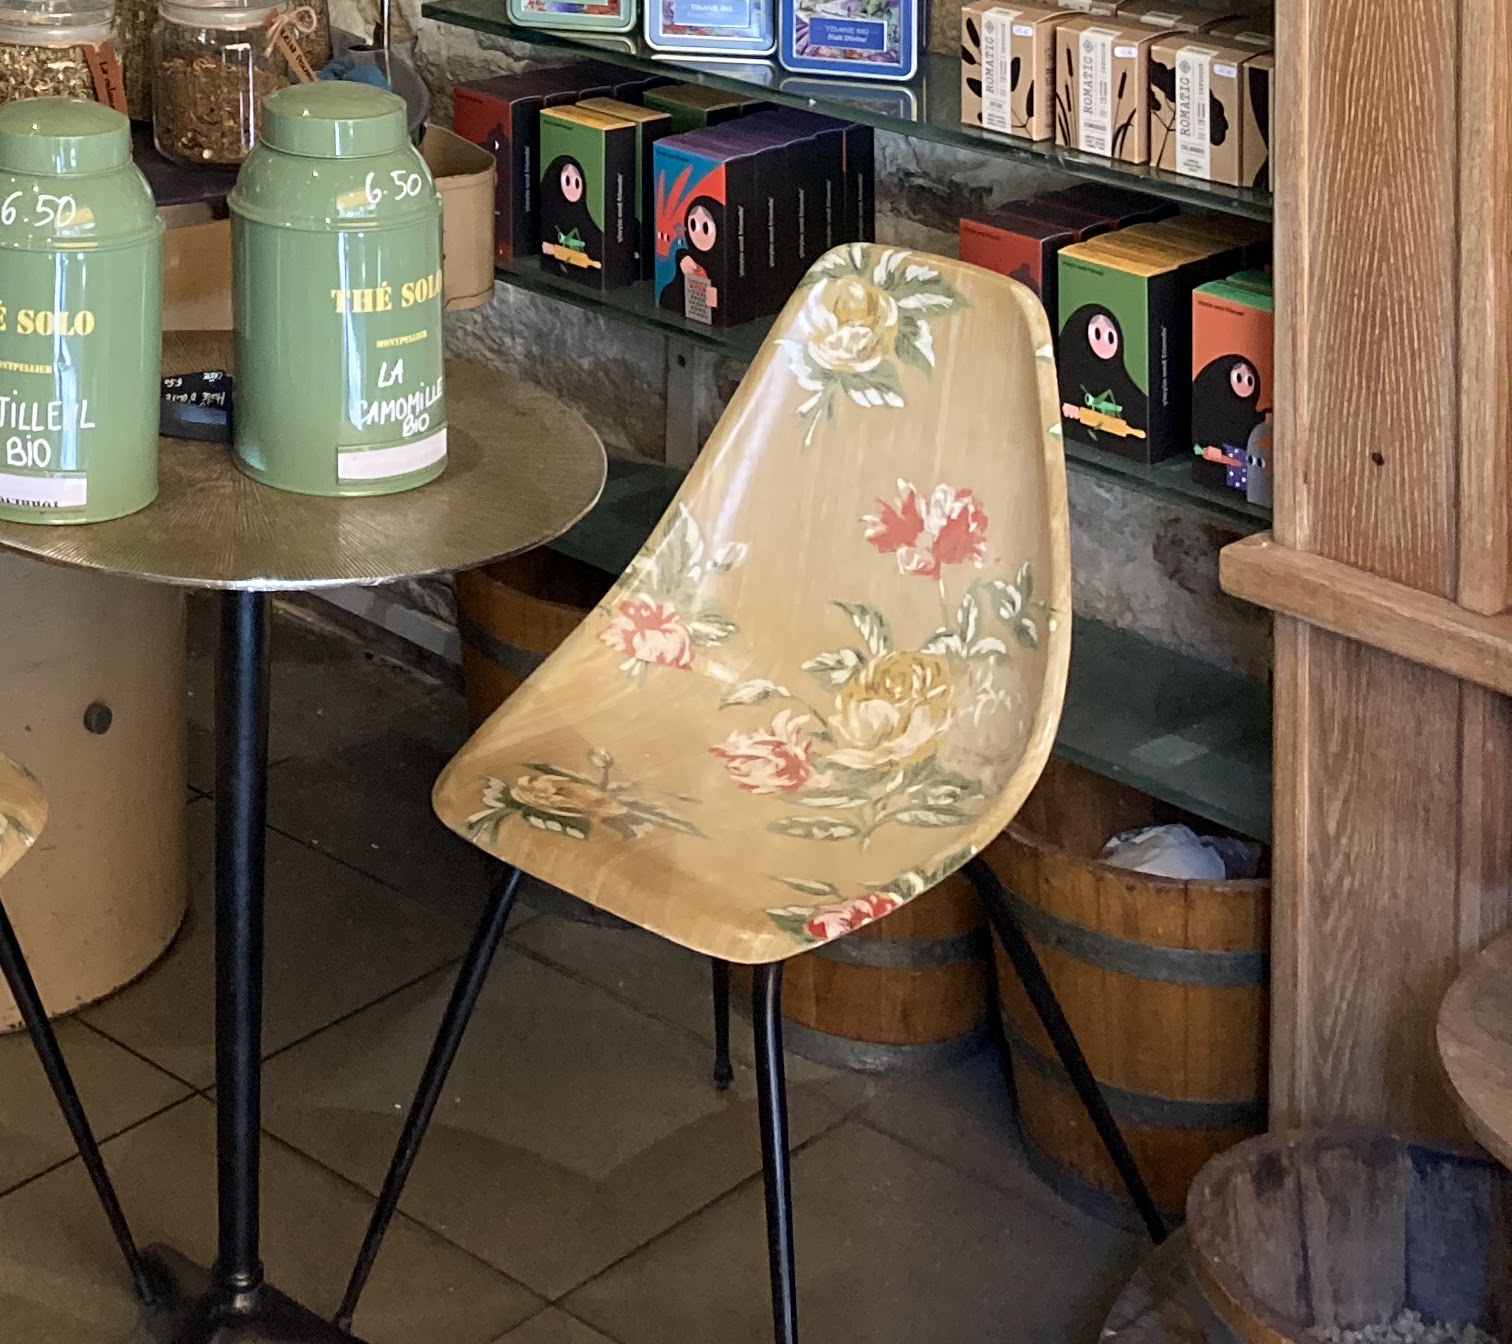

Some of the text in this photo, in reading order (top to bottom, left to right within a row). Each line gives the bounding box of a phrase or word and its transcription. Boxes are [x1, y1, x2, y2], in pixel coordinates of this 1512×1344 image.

[1083, 56, 1094, 115] ROMATIC
[1180, 77, 1191, 137] ROMATIC
[1, 191, 76, 227] 6.50
[331, 269, 443, 313] THÉ SOLO
[16, 309, 95, 336] SOLO
[378, 358, 403, 388] LA
